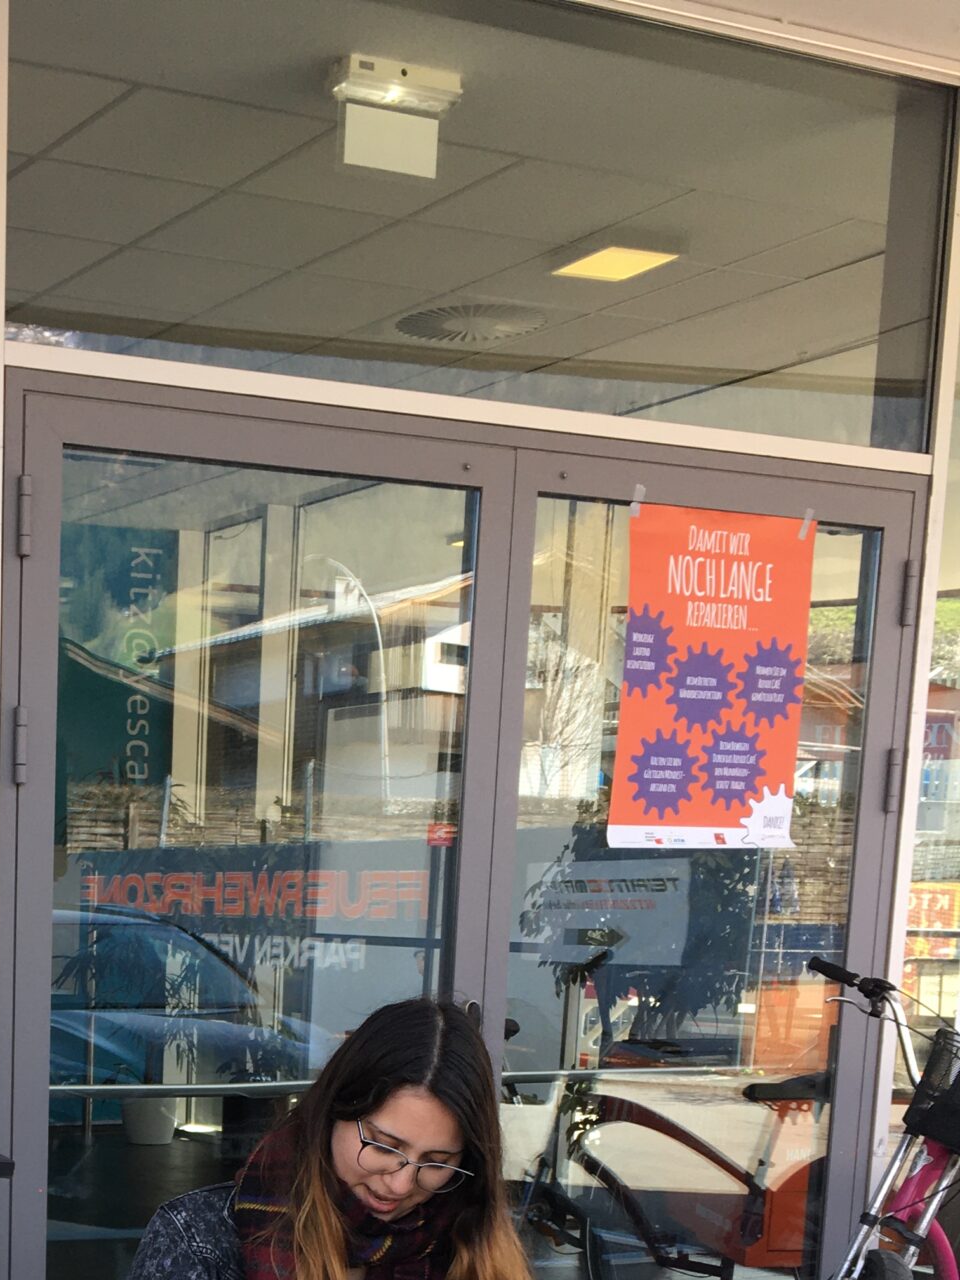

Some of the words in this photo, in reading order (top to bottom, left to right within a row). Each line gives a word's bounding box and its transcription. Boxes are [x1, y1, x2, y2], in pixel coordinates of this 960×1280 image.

[688, 525, 728, 554] DAMIT
[730, 533, 751, 556] WIR
[667, 555, 715, 598] NOCH
[720, 560, 774, 602] LANGE
